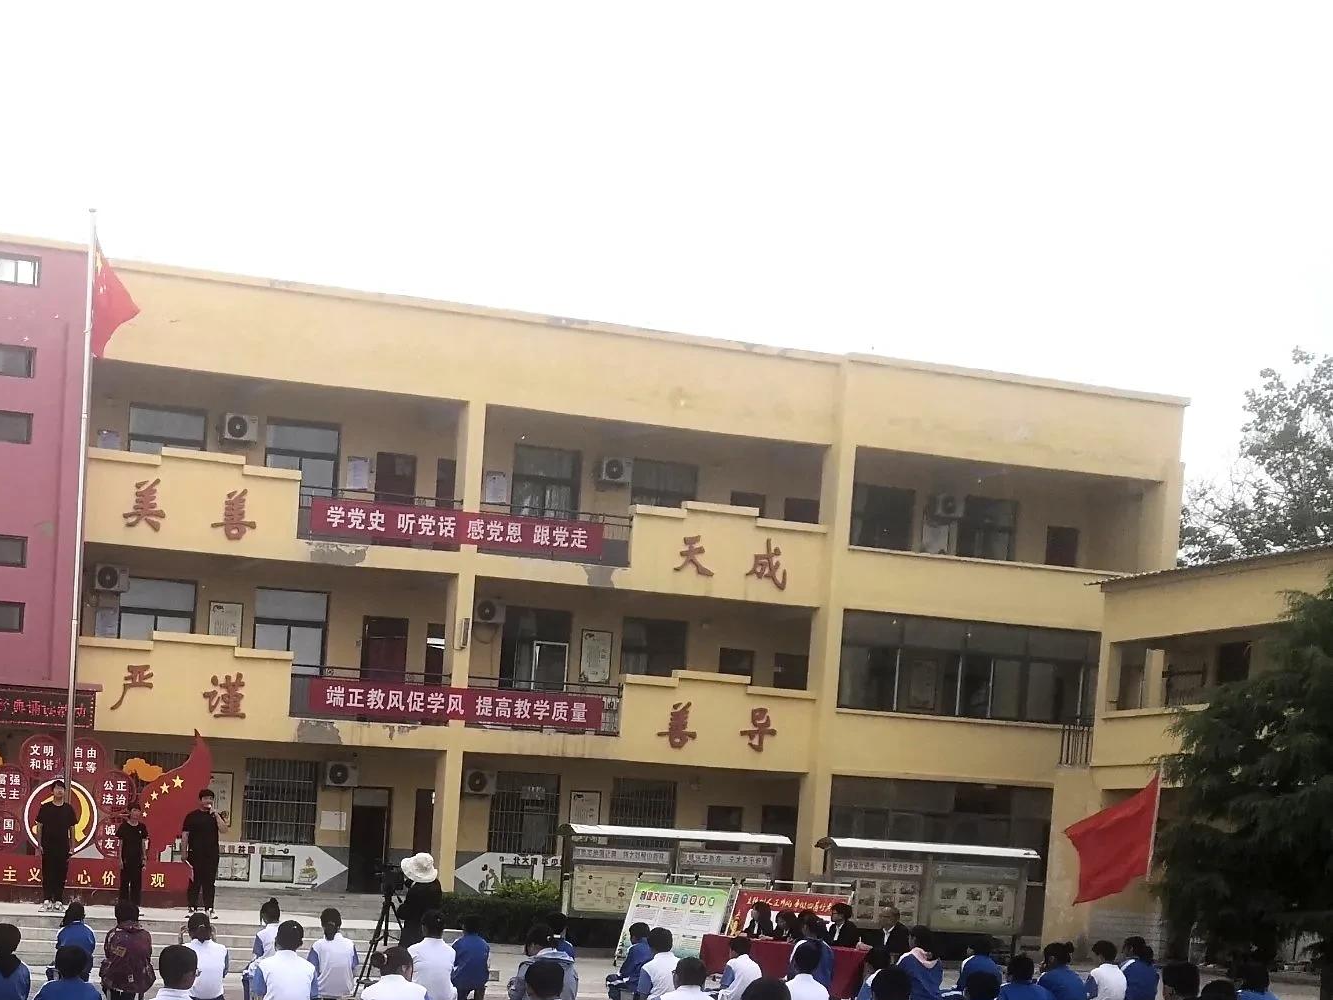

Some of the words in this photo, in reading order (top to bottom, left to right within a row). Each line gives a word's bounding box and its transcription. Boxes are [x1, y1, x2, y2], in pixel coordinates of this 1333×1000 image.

[326, 505, 386, 532] 学党史
[397, 512, 456, 539] 听党话
[466, 519, 523, 544] 感党恩
[533, 524, 589, 550] 跟党走
[673, 534, 787, 591] 天成
[109, 664, 247, 719] 严谨
[326, 685, 465, 715] 端正教风促学风
[475, 695, 588, 724] 提高教学质量
[29, 743, 54, 757] 文明
[74, 746, 97, 759] 自由
[29, 758, 55, 771] 和谐
[73, 760, 97, 773] 平等
[103, 780, 127, 792] 公正
[102, 793, 127, 806] 法治
